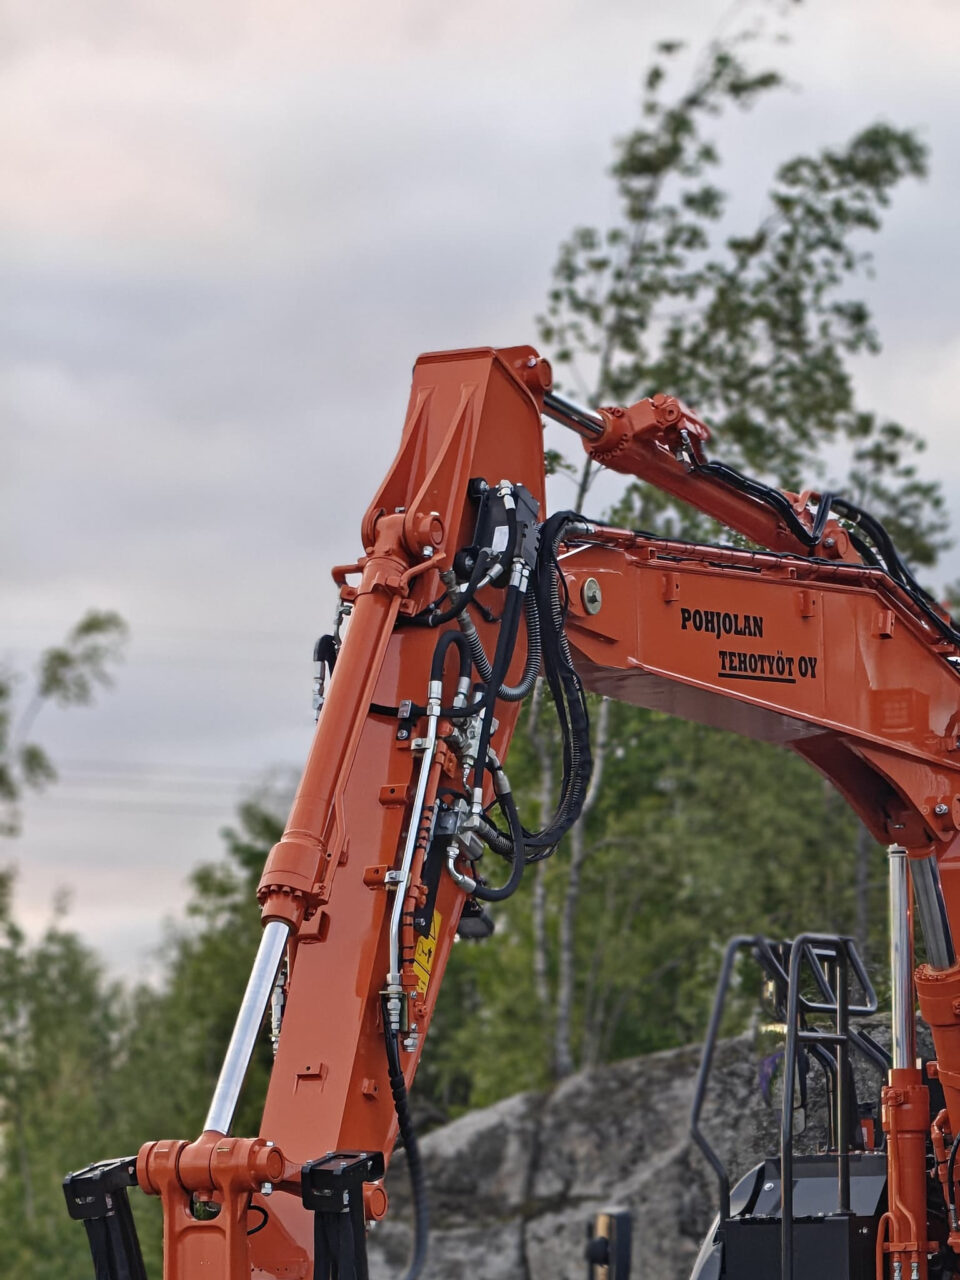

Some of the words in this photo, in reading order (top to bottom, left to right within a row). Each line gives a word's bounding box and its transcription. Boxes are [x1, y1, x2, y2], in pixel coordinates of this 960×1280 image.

[680, 607, 763, 640] POHJOLAN
[718, 650, 795, 677] TEHOTYÖT
[798, 656, 817, 679] OY
